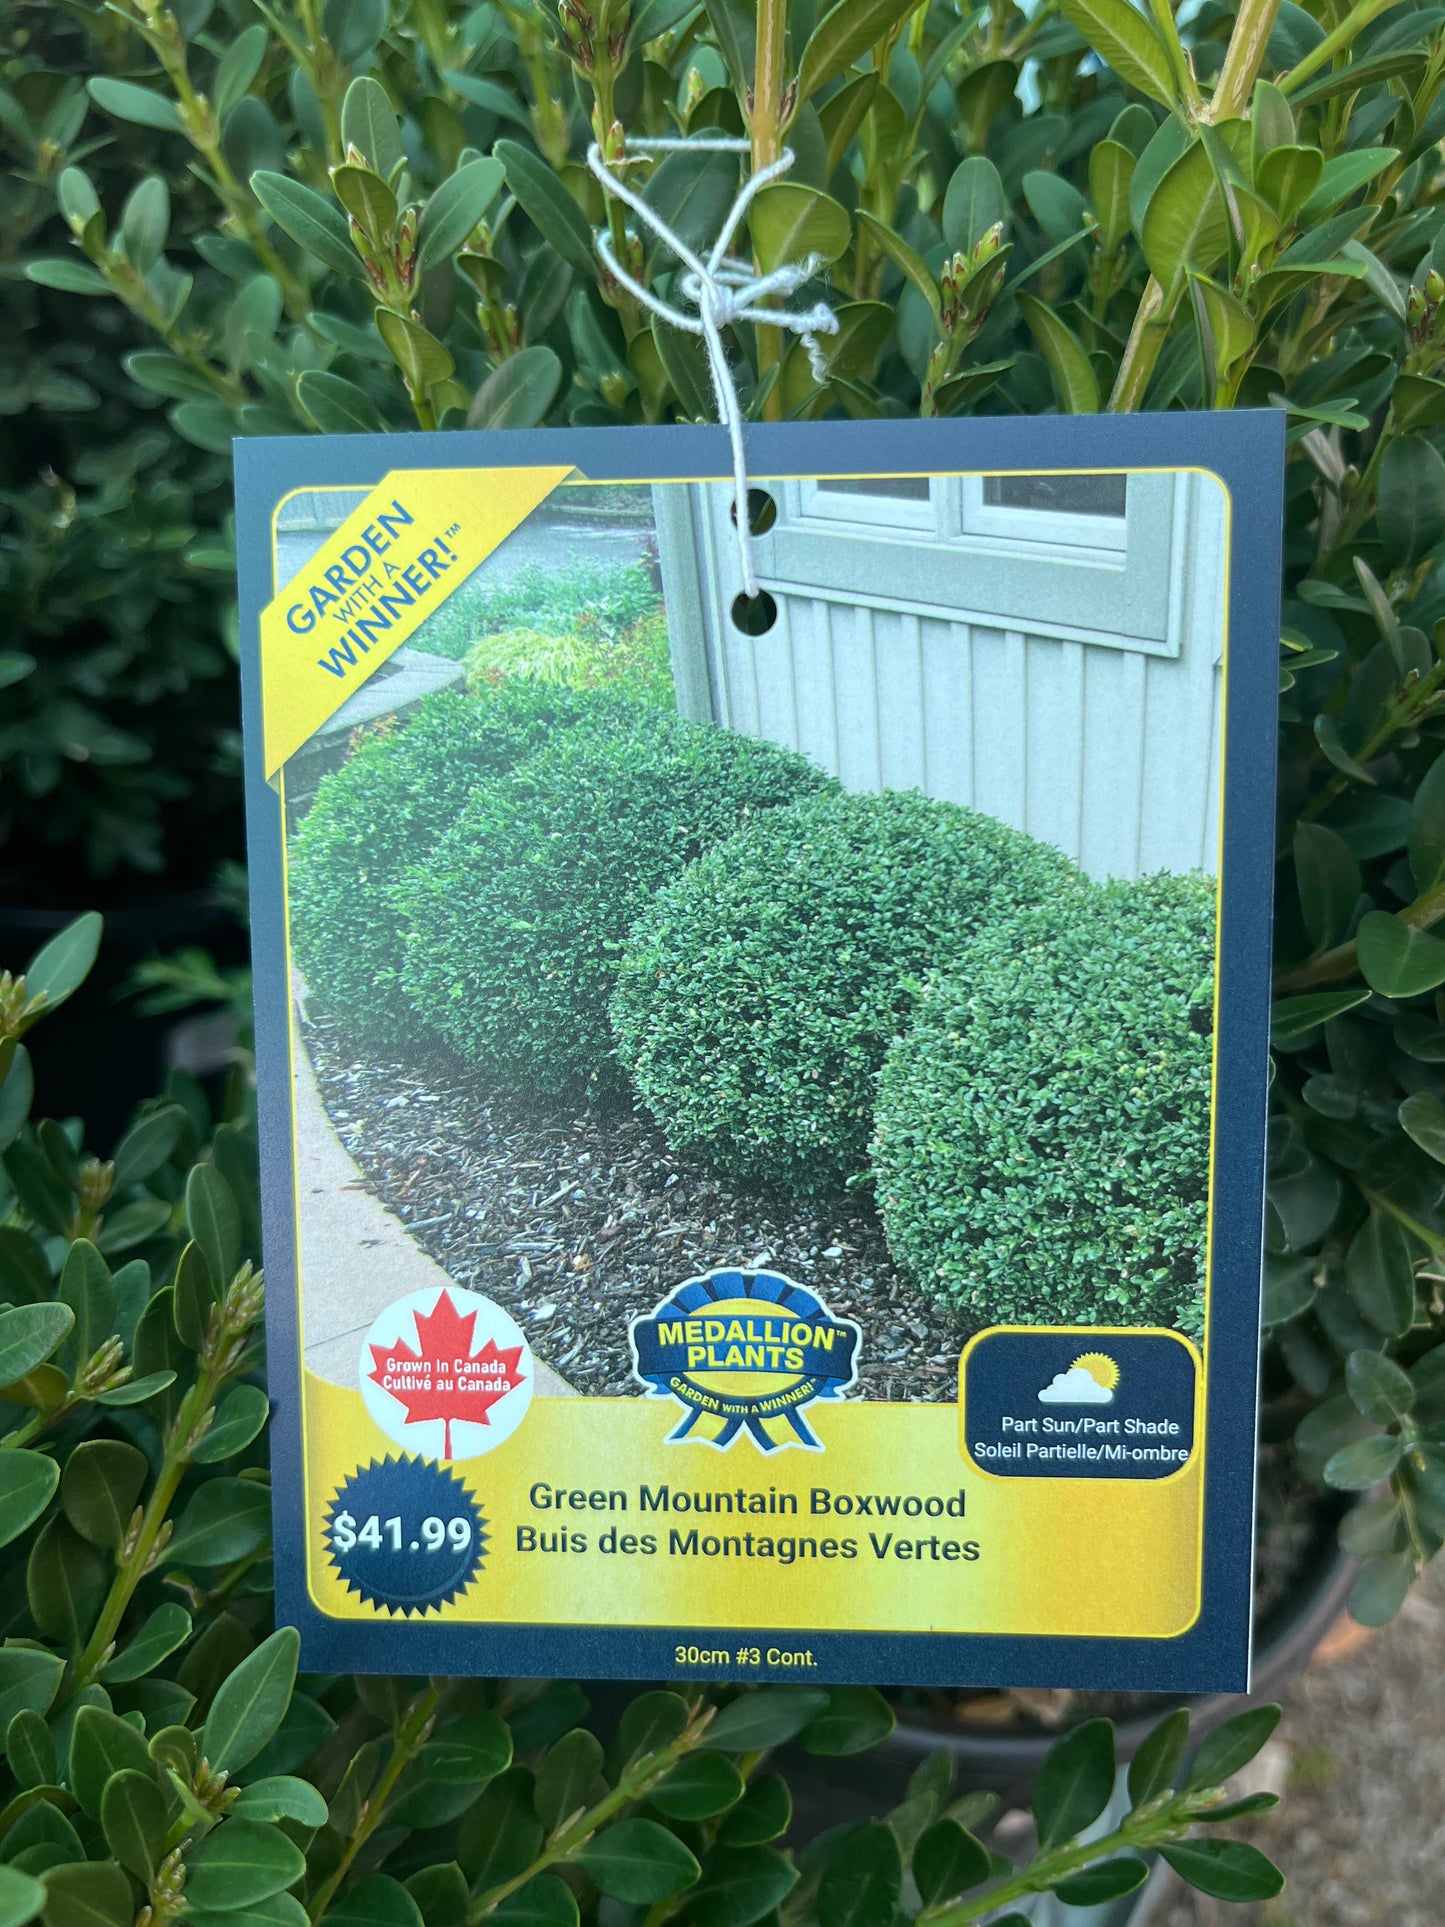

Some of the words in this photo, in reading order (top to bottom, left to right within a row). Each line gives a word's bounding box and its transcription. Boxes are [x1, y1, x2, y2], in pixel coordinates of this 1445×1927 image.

[286, 500, 414, 634] GARDEN
[333, 574, 384, 625] WITH
[384, 560, 401, 581] A
[386, 1357, 432, 1372] Grown
[436, 1358, 449, 1373] In
[453, 1359, 506, 1374] Canada
[688, 1345, 804, 1370] PLANTS
[383, 1374, 432, 1390] Cultivé
[436, 1378, 454, 1391] au
[457, 1376, 511, 1391] Canada
[669, 1376, 719, 1411] GARDEN
[722, 1401, 749, 1414] WITH
[751, 1404, 760, 1414] A
[1002, 1416, 1038, 1433] Part
[1042, 1417, 1120, 1435] Sun/Part
[1124, 1418, 1180, 1435] Shade
[974, 1442, 1021, 1458] Soleil
[1026, 1443, 1189, 1461] Partielle/Mi-ombre
[530, 1482, 628, 1511] Green
[640, 1484, 798, 1514] Mountain
[810, 1487, 966, 1517] Boxwood
[333, 1510, 472, 1553] $41.99
[516, 1525, 587, 1553] Buis
[599, 1526, 657, 1555] des
[669, 1528, 858, 1564] Montagnes
[868, 1531, 981, 1561] Vertes
[674, 1646, 730, 1664] 30cm
[736, 1647, 761, 1665] #3
[767, 1648, 818, 1666] Cont.
